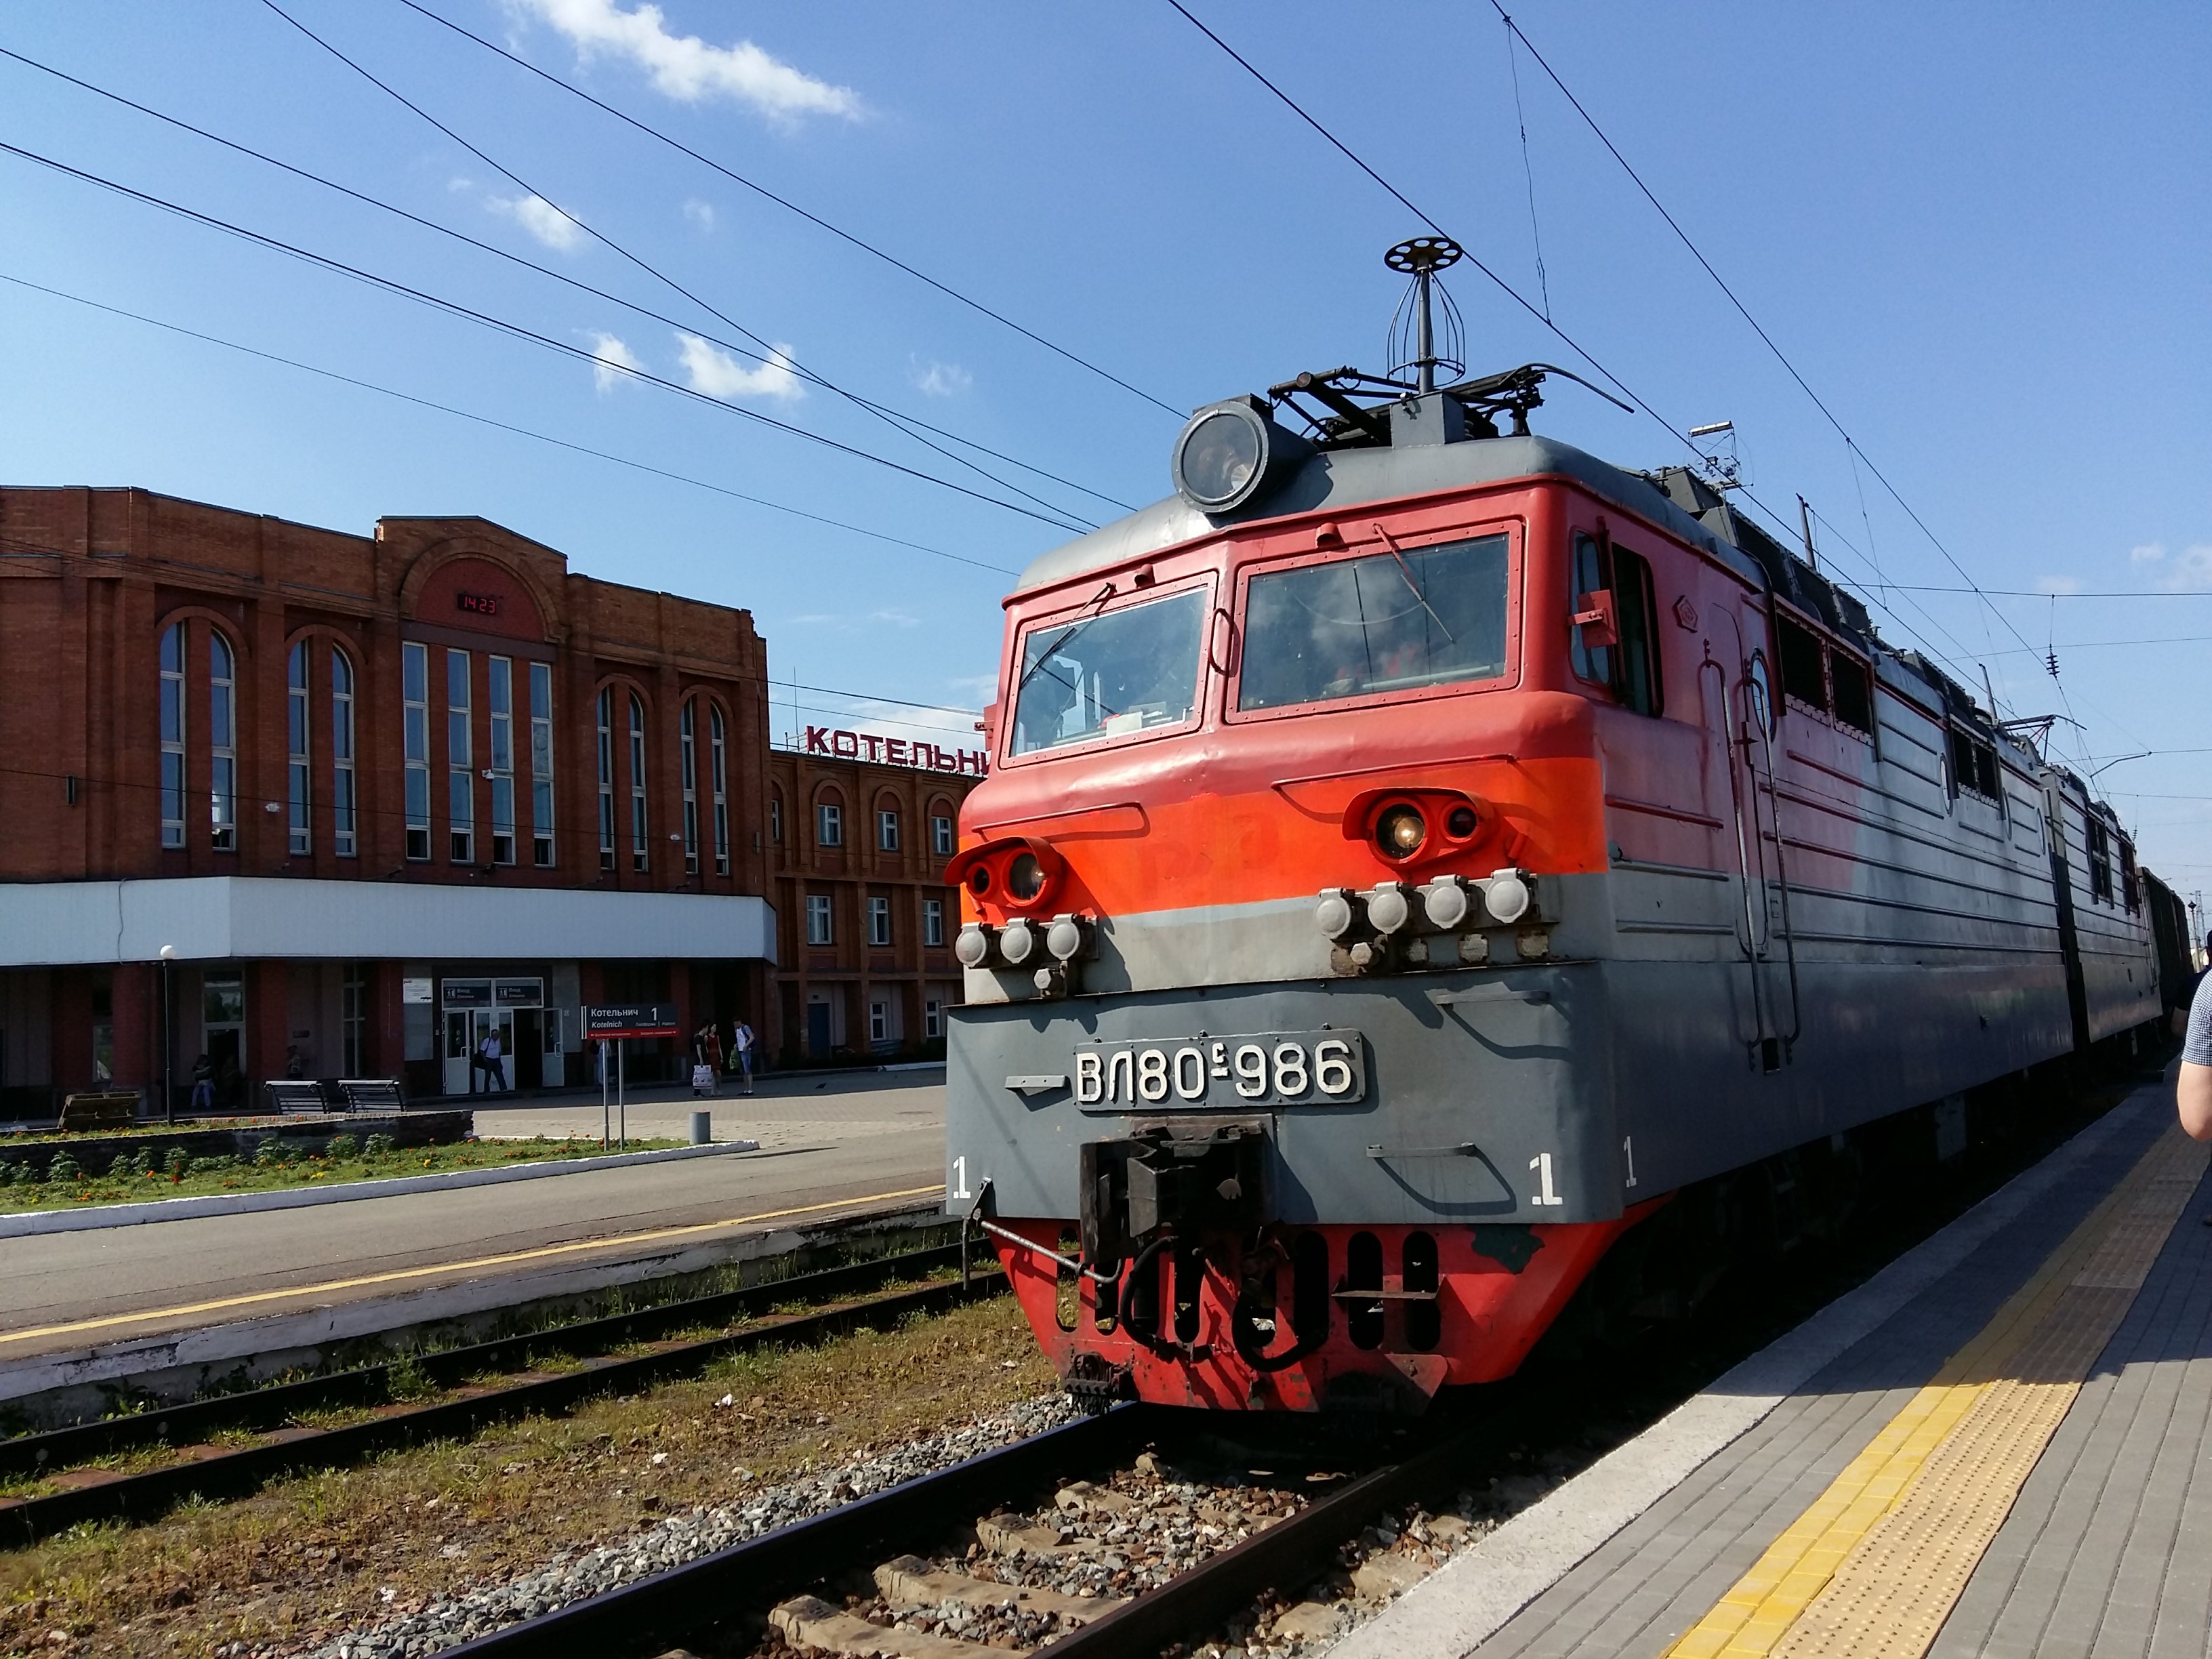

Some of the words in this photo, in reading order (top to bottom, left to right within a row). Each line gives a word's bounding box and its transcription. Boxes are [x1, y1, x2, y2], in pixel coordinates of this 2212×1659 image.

[464, 596, 476, 609] 14
[479, 598, 495, 613] 23
[591, 1008, 638, 1017] Котельнич
[651, 1007, 657, 1021] 1
[1624, 1136, 1637, 1187] 1
[953, 1156, 971, 1199] 1
[1530, 1153, 1563, 1205] 1
